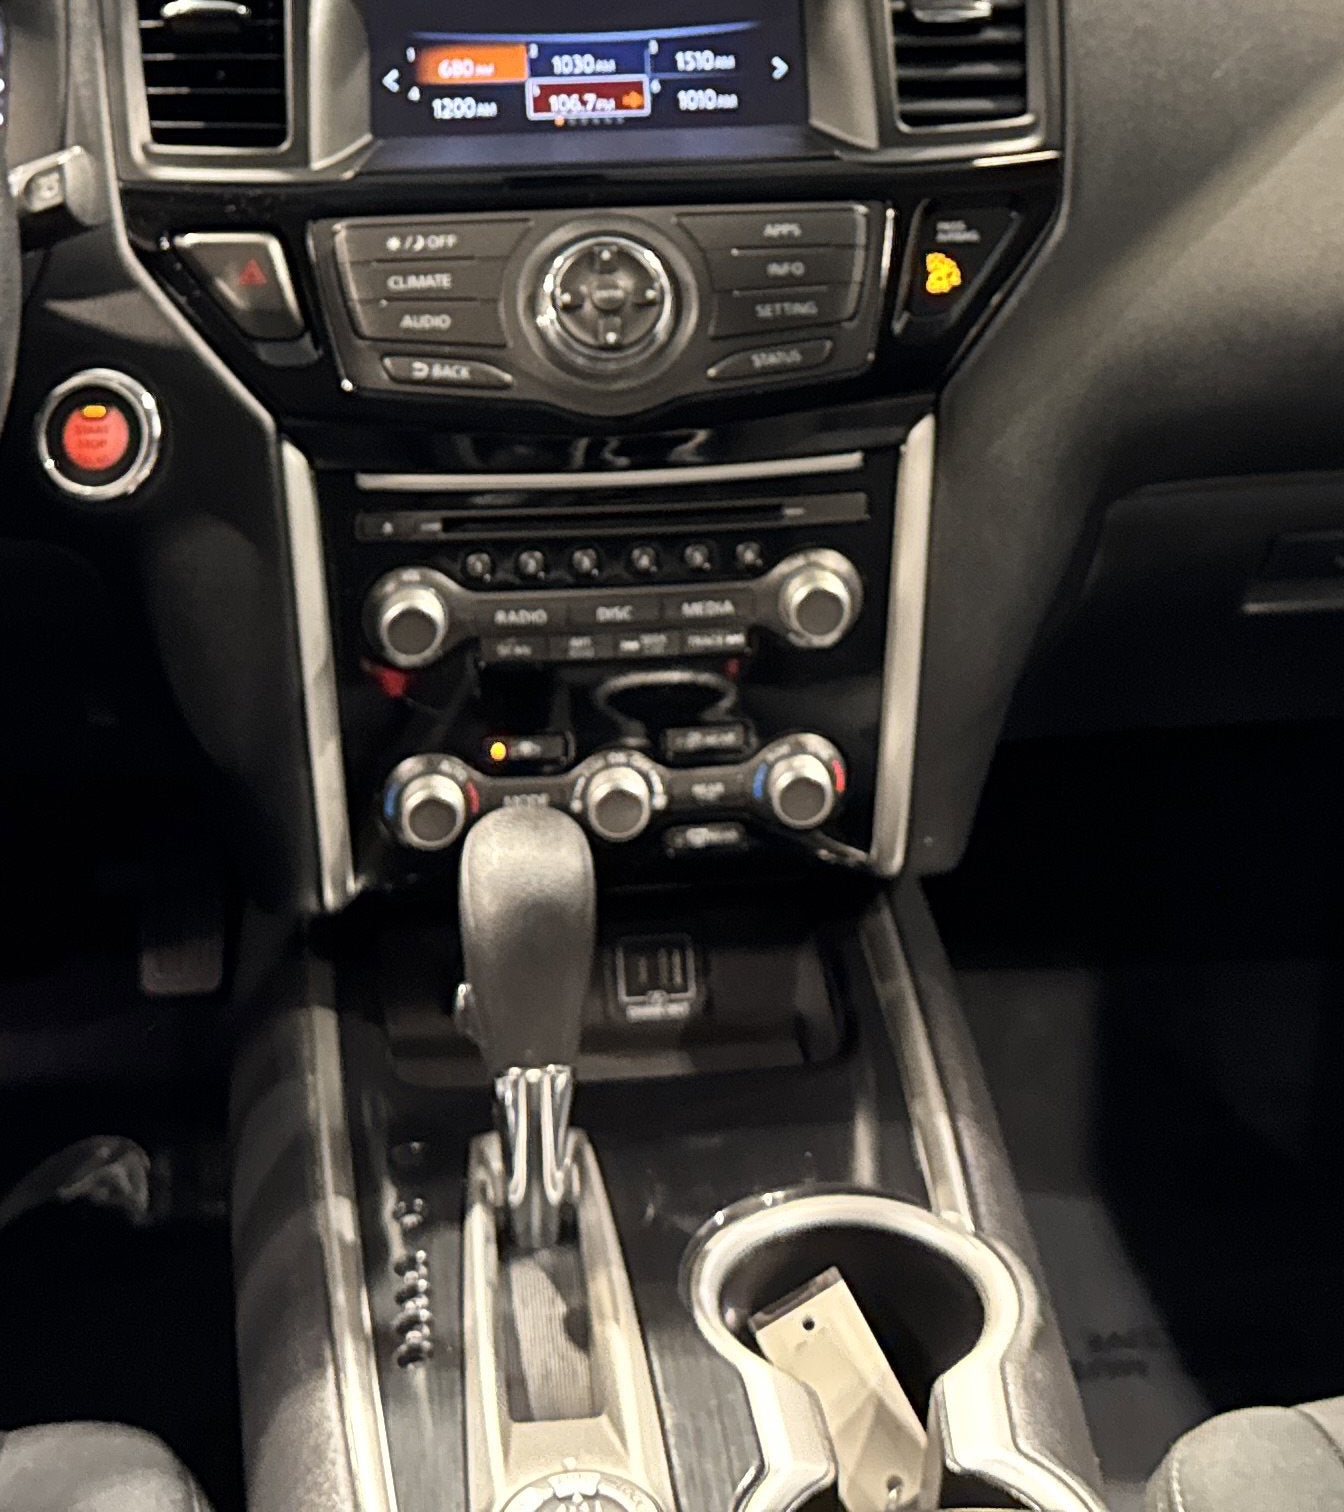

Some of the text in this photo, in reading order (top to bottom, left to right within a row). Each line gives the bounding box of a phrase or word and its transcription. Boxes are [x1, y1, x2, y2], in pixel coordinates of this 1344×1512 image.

[426, 234, 457, 250] OFF
[386, 273, 453, 292] CLIMATE
[399, 313, 452, 330] AUDIO
[431, 362, 472, 380] BACK
[494, 608, 548, 625] RADIO
[595, 605, 634, 623] DISC
[681, 599, 735, 618] MEDIA
